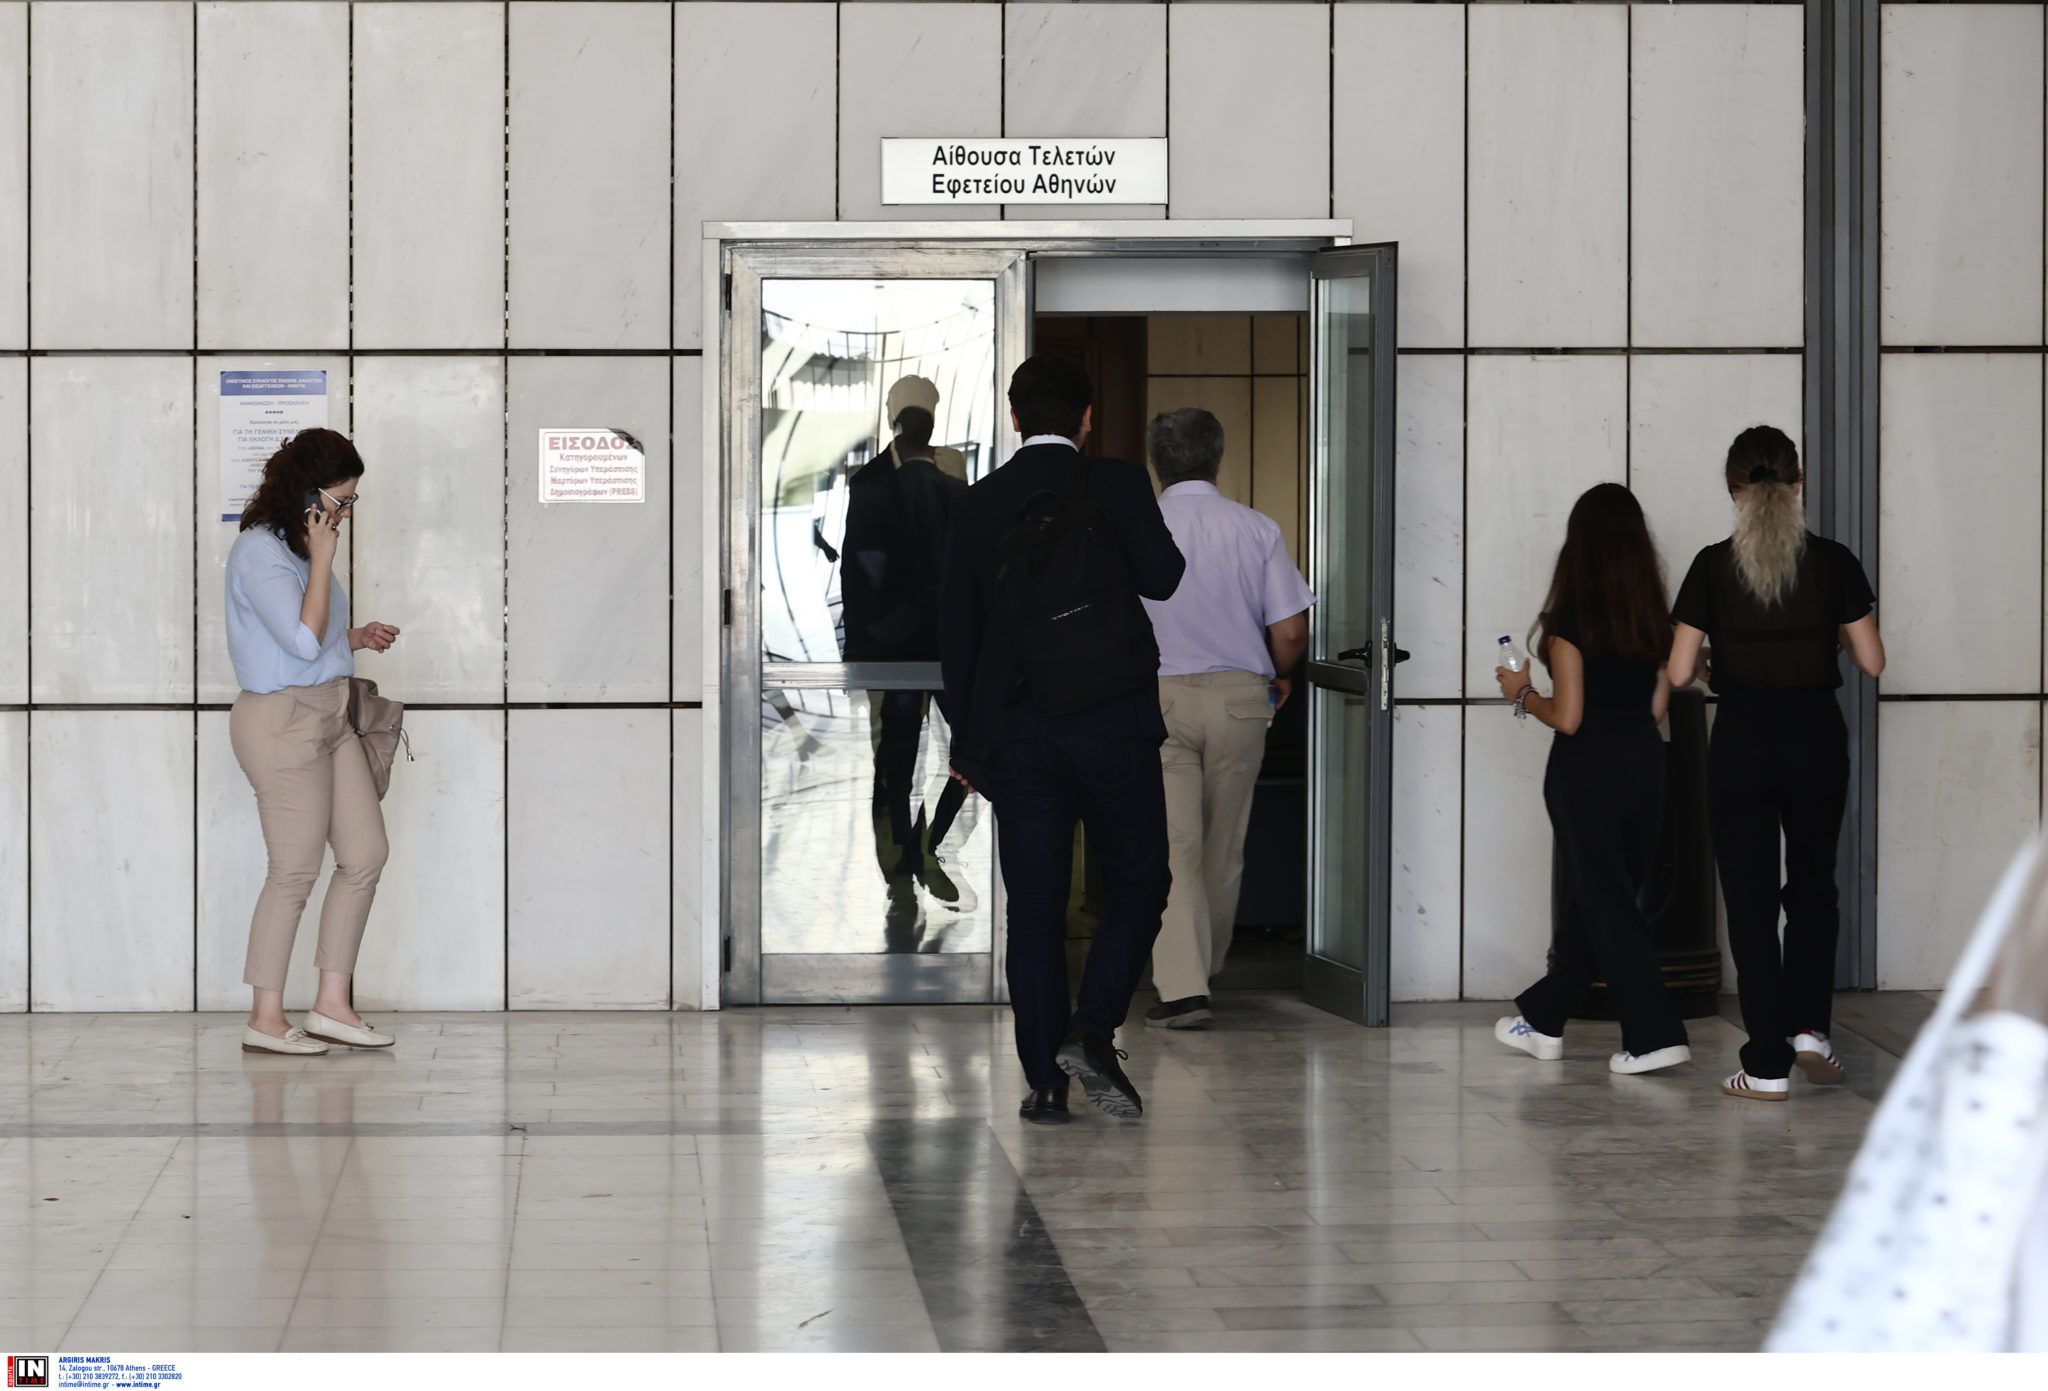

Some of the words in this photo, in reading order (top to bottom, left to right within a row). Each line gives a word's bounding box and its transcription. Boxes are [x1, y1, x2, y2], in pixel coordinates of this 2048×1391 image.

[932, 145, 1021, 166] Αίθουσα
[1028, 145, 1116, 166] Τελετών
[932, 173, 1025, 198] Εφετείου
[1032, 173, 1117, 198] Αθηνών
[559, 453, 628, 463] Κατηγορουμένων
[549, 465, 589, 474] Συνηγόρων
[590, 465, 638, 474] Υπεράσπισης
[550, 477, 588, 485] Μαρτύρων
[590, 477, 637, 485] Υπεράσπισης
[549, 488, 608, 497] Δημοσιογράφων
[609, 487, 638, 496] (PRESS)
